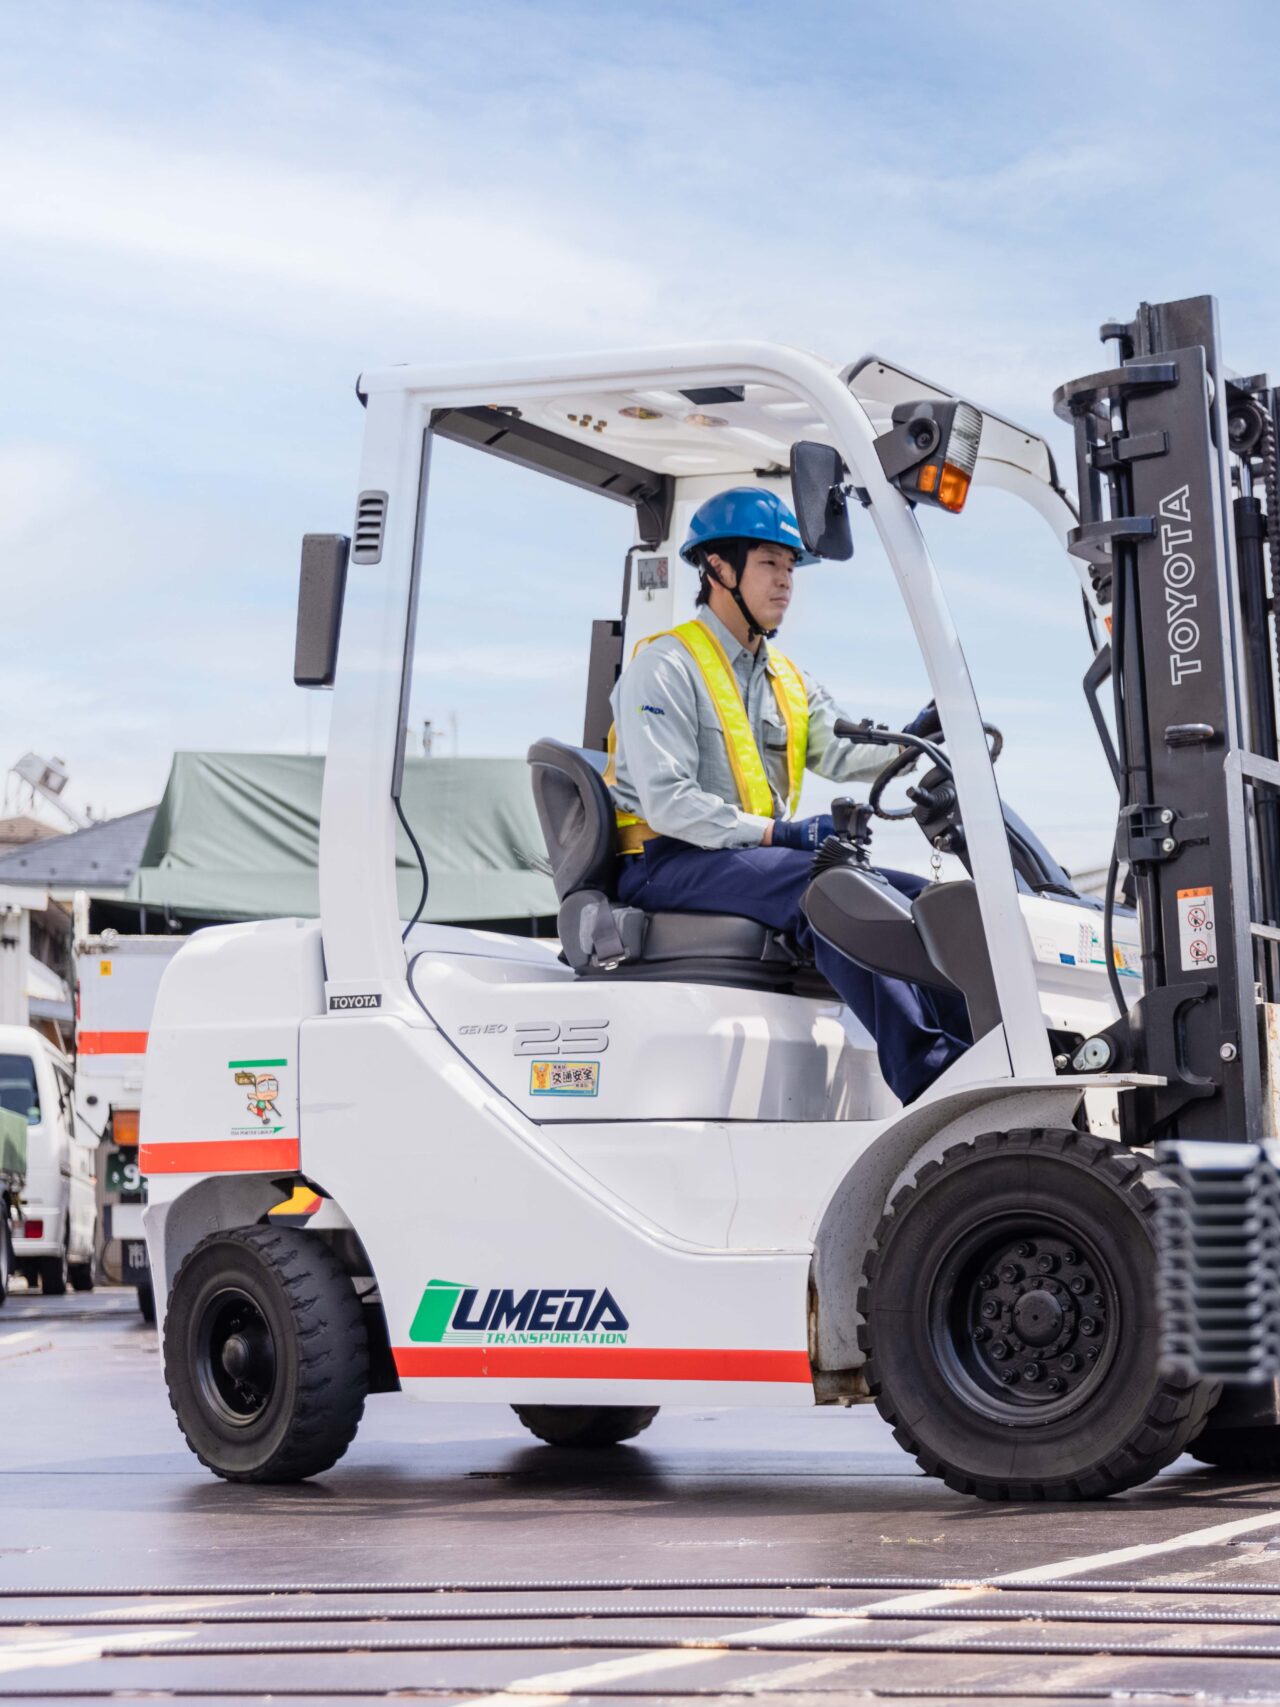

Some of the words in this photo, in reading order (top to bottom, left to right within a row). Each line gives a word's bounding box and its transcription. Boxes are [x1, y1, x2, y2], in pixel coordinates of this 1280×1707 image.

[1159, 484, 1202, 686] TOYOTA
[332, 995, 378, 1009] TOYOTA
[458, 1023, 508, 1036] GENEO
[513, 1019, 610, 1057] 25
[452, 1287, 630, 1332] UMEDA
[486, 1333, 628, 1344] TRANSPORTATION
